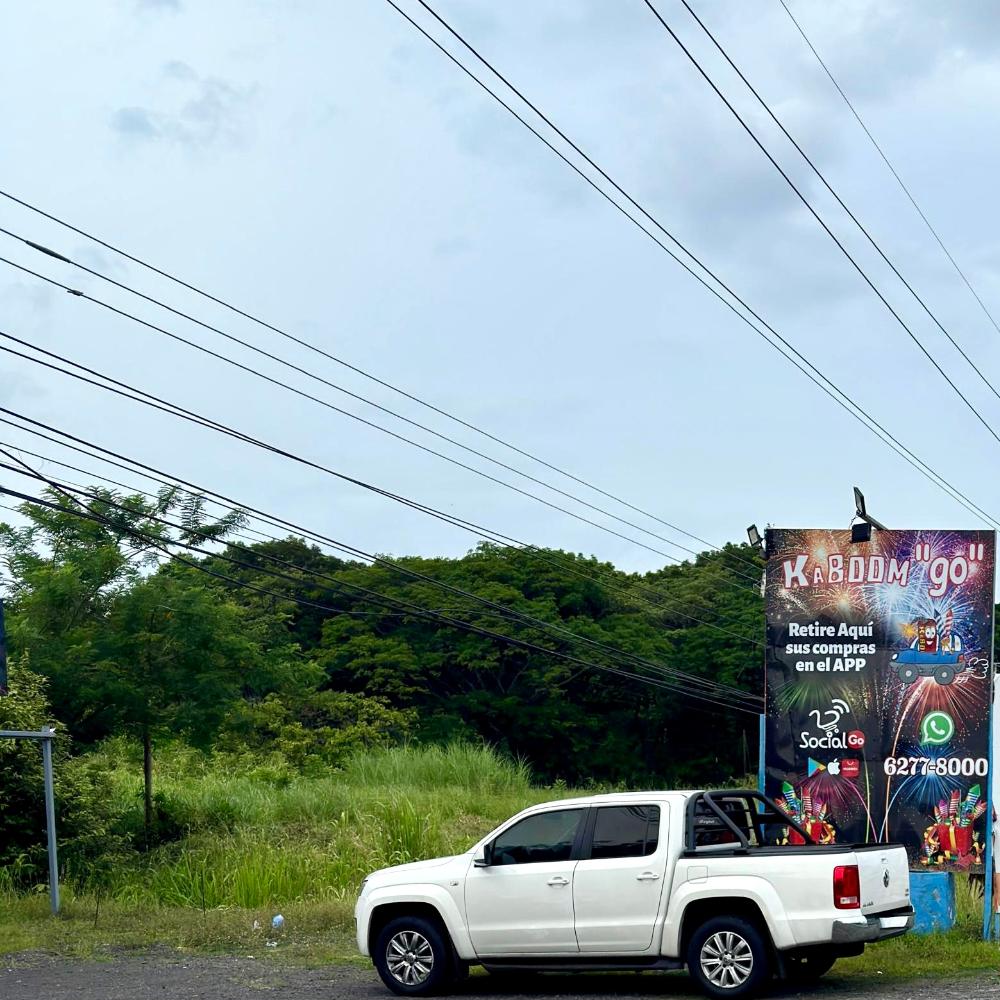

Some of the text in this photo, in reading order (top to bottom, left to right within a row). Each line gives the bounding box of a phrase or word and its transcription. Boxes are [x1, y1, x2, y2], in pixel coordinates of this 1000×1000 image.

[788, 621, 874, 640] Retire Aquí
[785, 643, 876, 658] sus compras
[796, 657, 867, 672] en el APP
[800, 731, 865, 749] Social Go
[884, 756, 988, 776] 6277-8000
